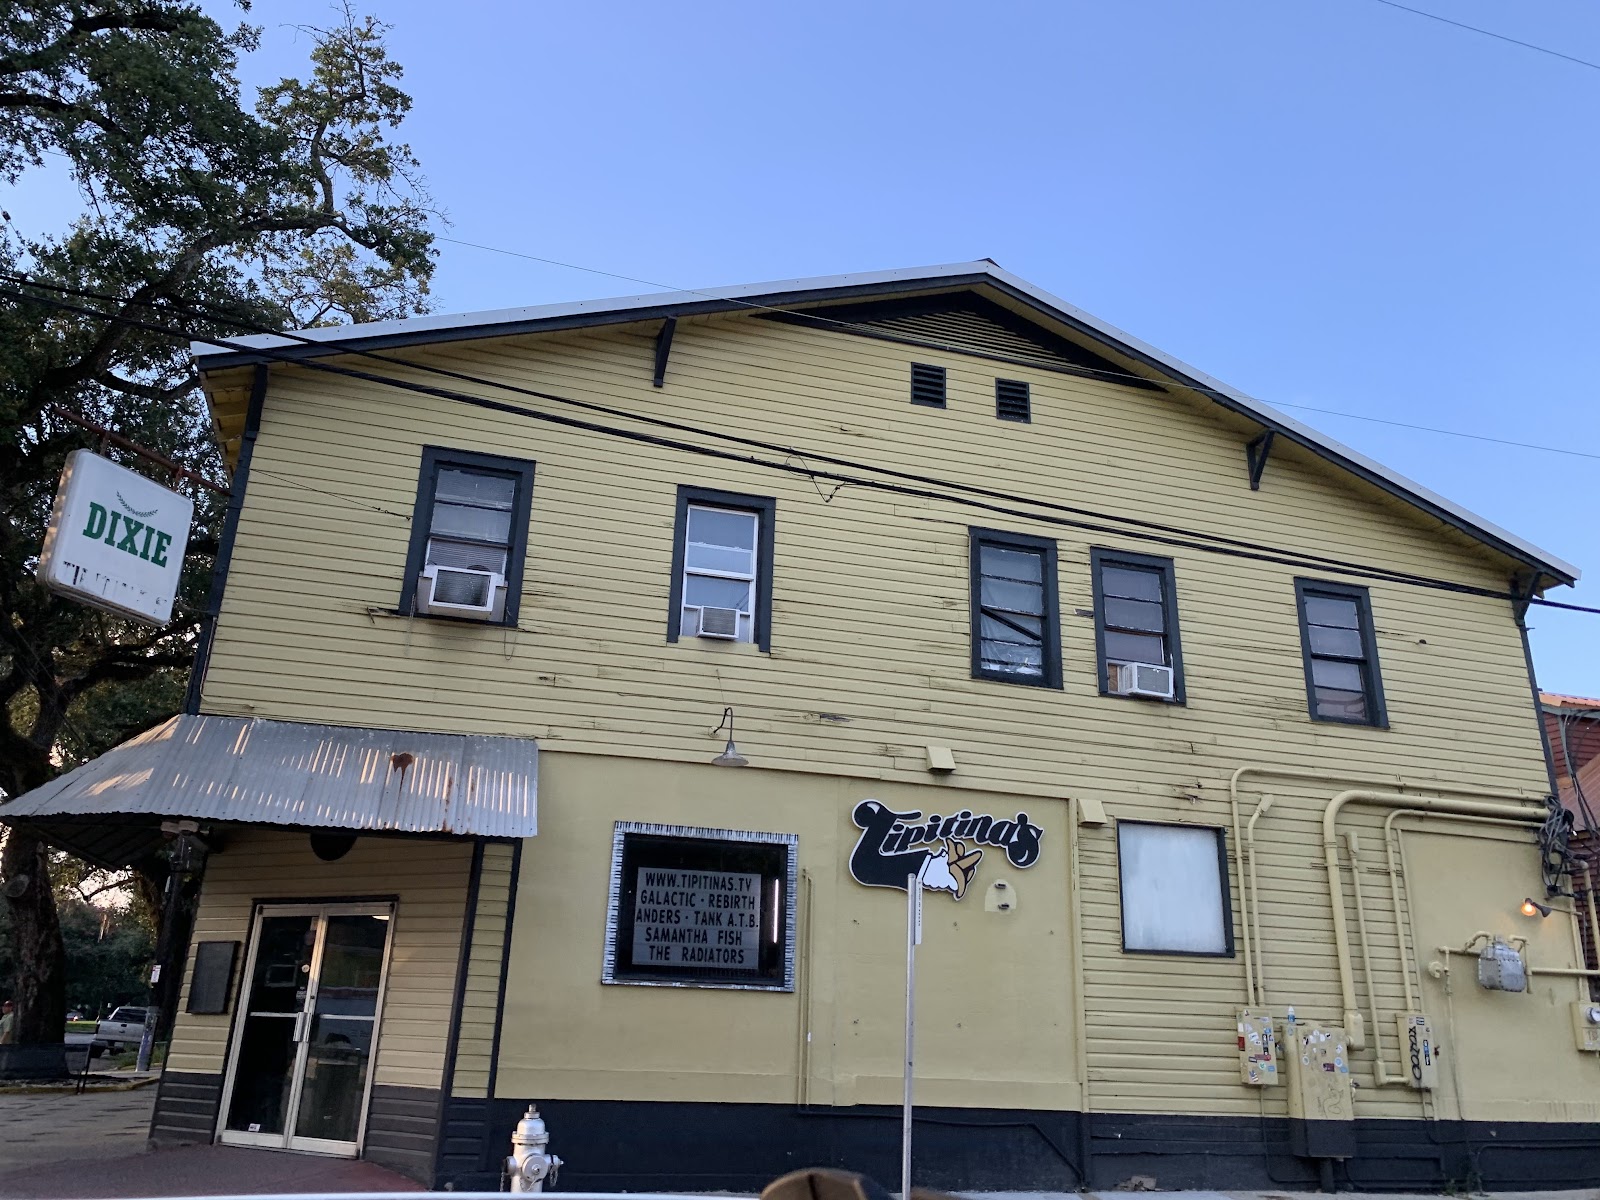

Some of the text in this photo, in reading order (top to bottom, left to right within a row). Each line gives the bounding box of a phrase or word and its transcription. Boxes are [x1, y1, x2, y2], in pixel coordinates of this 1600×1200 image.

[83, 501, 172, 568] DIXIE
[850, 800, 1043, 888] Tipitina's
[645, 872, 752, 892] WWW.TIPITINAS.TV
[640, 890, 696, 907] GALACTIC
[708, 893, 755, 910] REBIRTH
[635, 908, 681, 925] ANDERS
[694, 911, 723, 926] TANK
[645, 927, 743, 946] SAMANTHA FISH
[649, 945, 745, 964] THE RADIATORS
